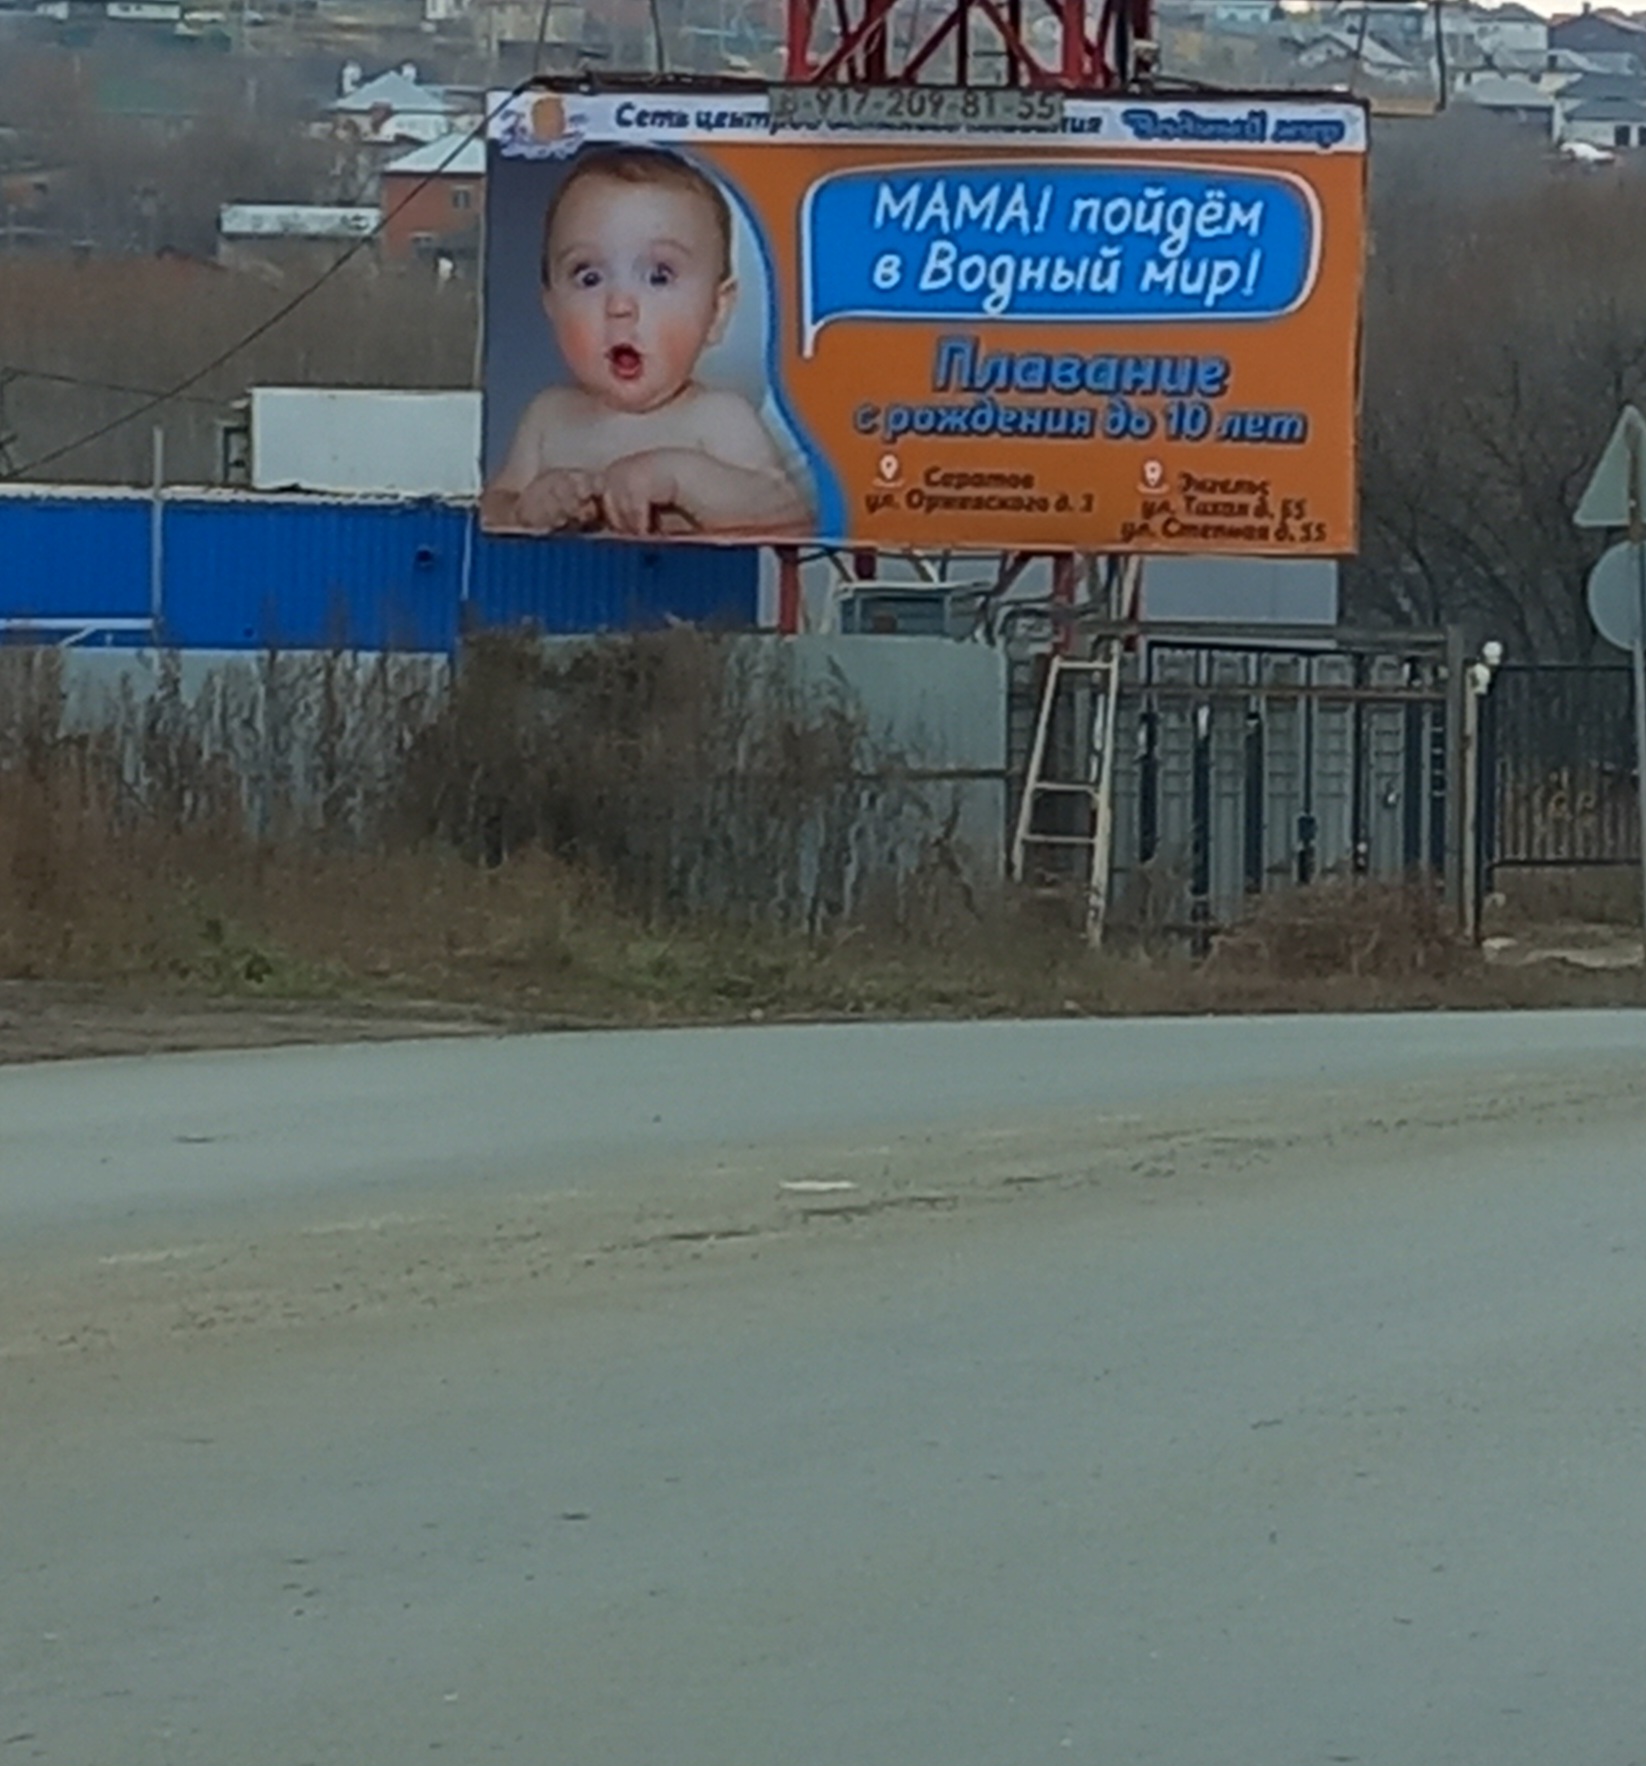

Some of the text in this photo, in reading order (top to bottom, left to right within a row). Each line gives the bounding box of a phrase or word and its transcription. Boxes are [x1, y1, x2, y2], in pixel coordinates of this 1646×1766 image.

[615, 102, 690, 129] Сеть
[872, 180, 1265, 256] МАМА! пойдём
[872, 239, 1263, 316] в Водный мир!
[933, 335, 1230, 398] Плавание
[853, 396, 1310, 446] с рождения до 10 лет
[923, 466, 1035, 490] Саратов
